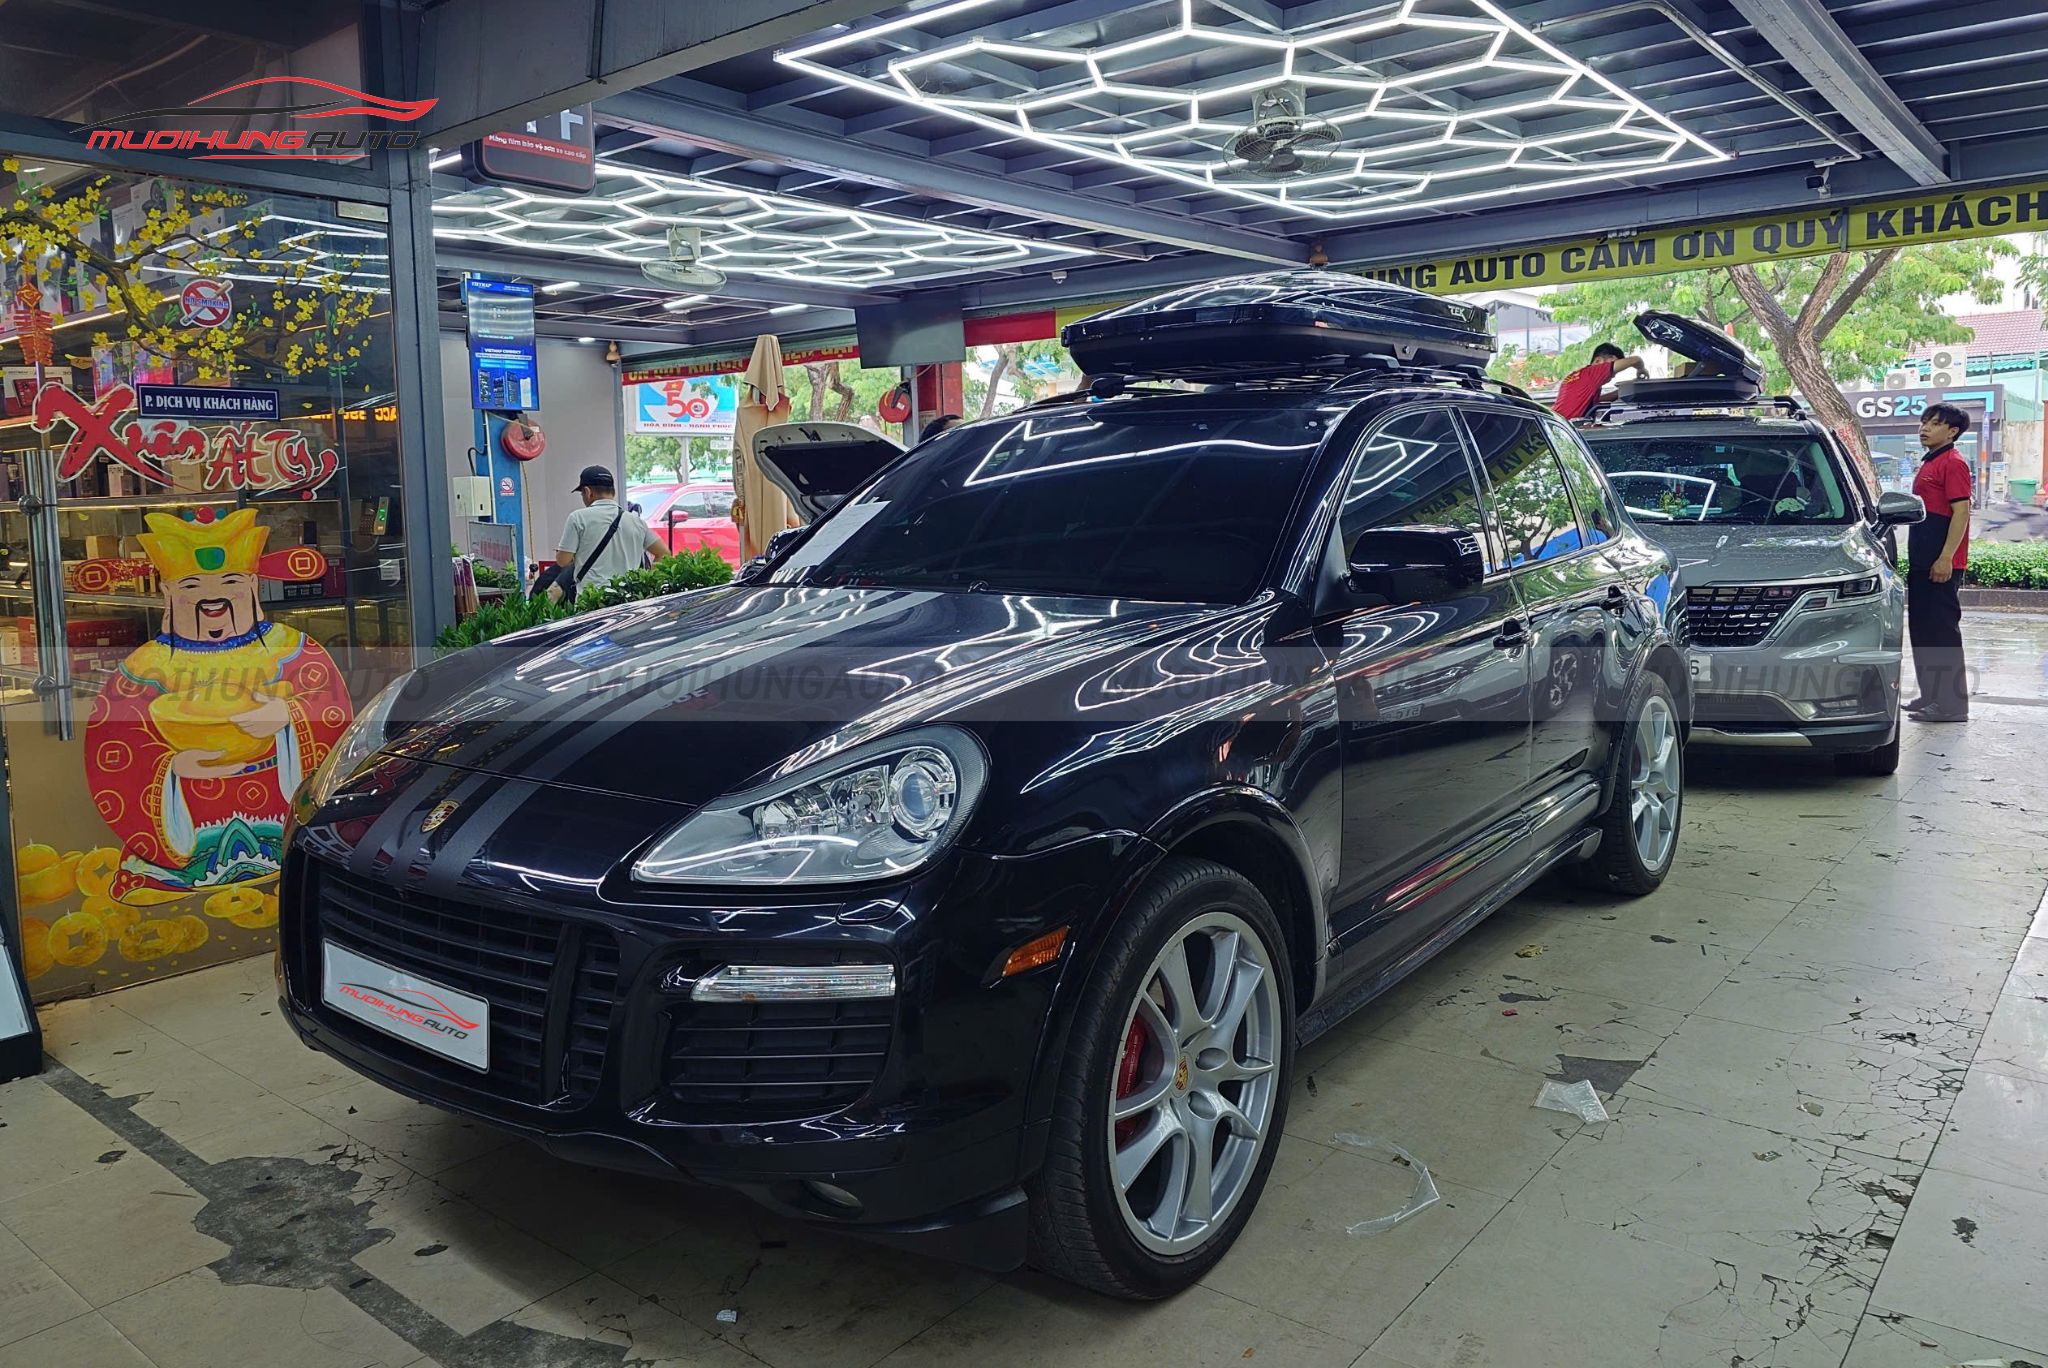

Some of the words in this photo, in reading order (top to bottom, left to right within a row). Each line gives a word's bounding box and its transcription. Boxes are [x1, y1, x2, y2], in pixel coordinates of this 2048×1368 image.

[1449, 251, 1546, 285] AUTO
[1560, 236, 1656, 274] CÁM
[1672, 229, 1735, 261] ƠN
[1752, 208, 1844, 255] QUÝ
[1865, 190, 2048, 241] KHÁCH
[145, 395, 154, 408] P.
[156, 395, 184, 412] DỊCH
[185, 396, 201, 412] VỤ
[202, 396, 241, 411] KHÁCH
[243, 397, 274, 412] HÀNG
[1856, 394, 1929, 419] GS25
